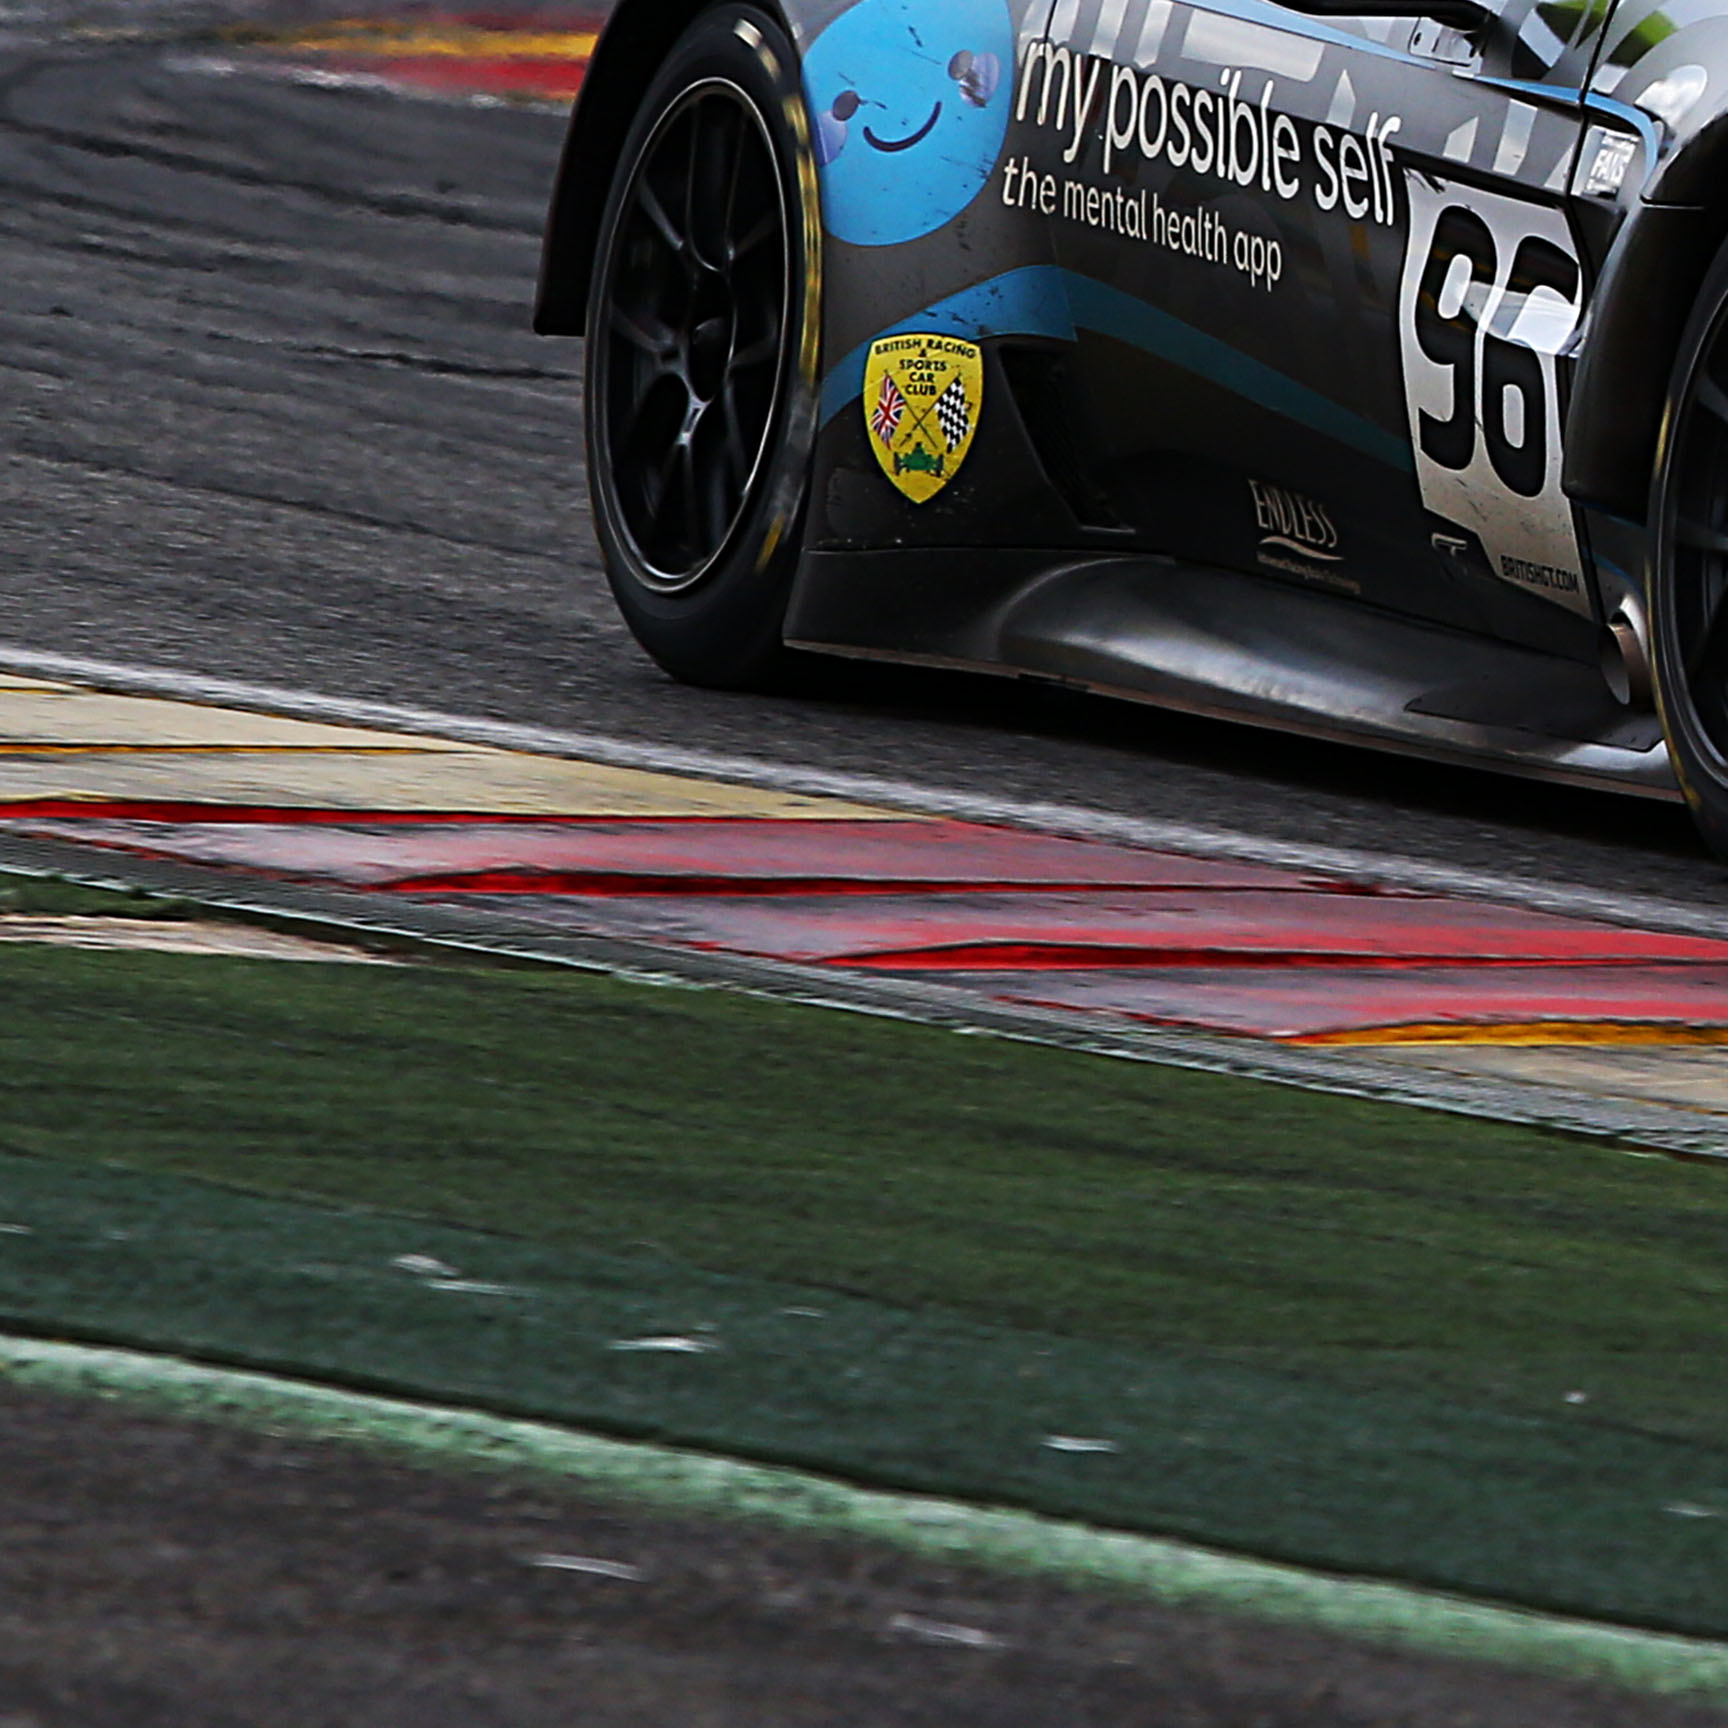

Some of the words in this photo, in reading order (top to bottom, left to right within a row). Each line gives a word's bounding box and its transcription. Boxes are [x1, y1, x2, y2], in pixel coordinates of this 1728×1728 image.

[1016, 41, 1100, 164] my
[1103, 66, 1301, 200] possible
[1312, 111, 1402, 226] self
[1002, 156, 1057, 215] the
[1063, 179, 1148, 241] mental
[1153, 192, 1228, 265] health
[1233, 231, 1283, 292] app
[875, 338, 922, 355] BRITISH
[926, 338, 976, 359] RACING
[899, 359, 947, 372] SPORTS
[1413, 203, 1580, 499] 96
[904, 384, 937, 396] CLUB
[909, 372, 935, 383] CAR
[1247, 478, 1338, 548] ENDLESS
[1500, 554, 1580, 594] BRITISHGT.COM
